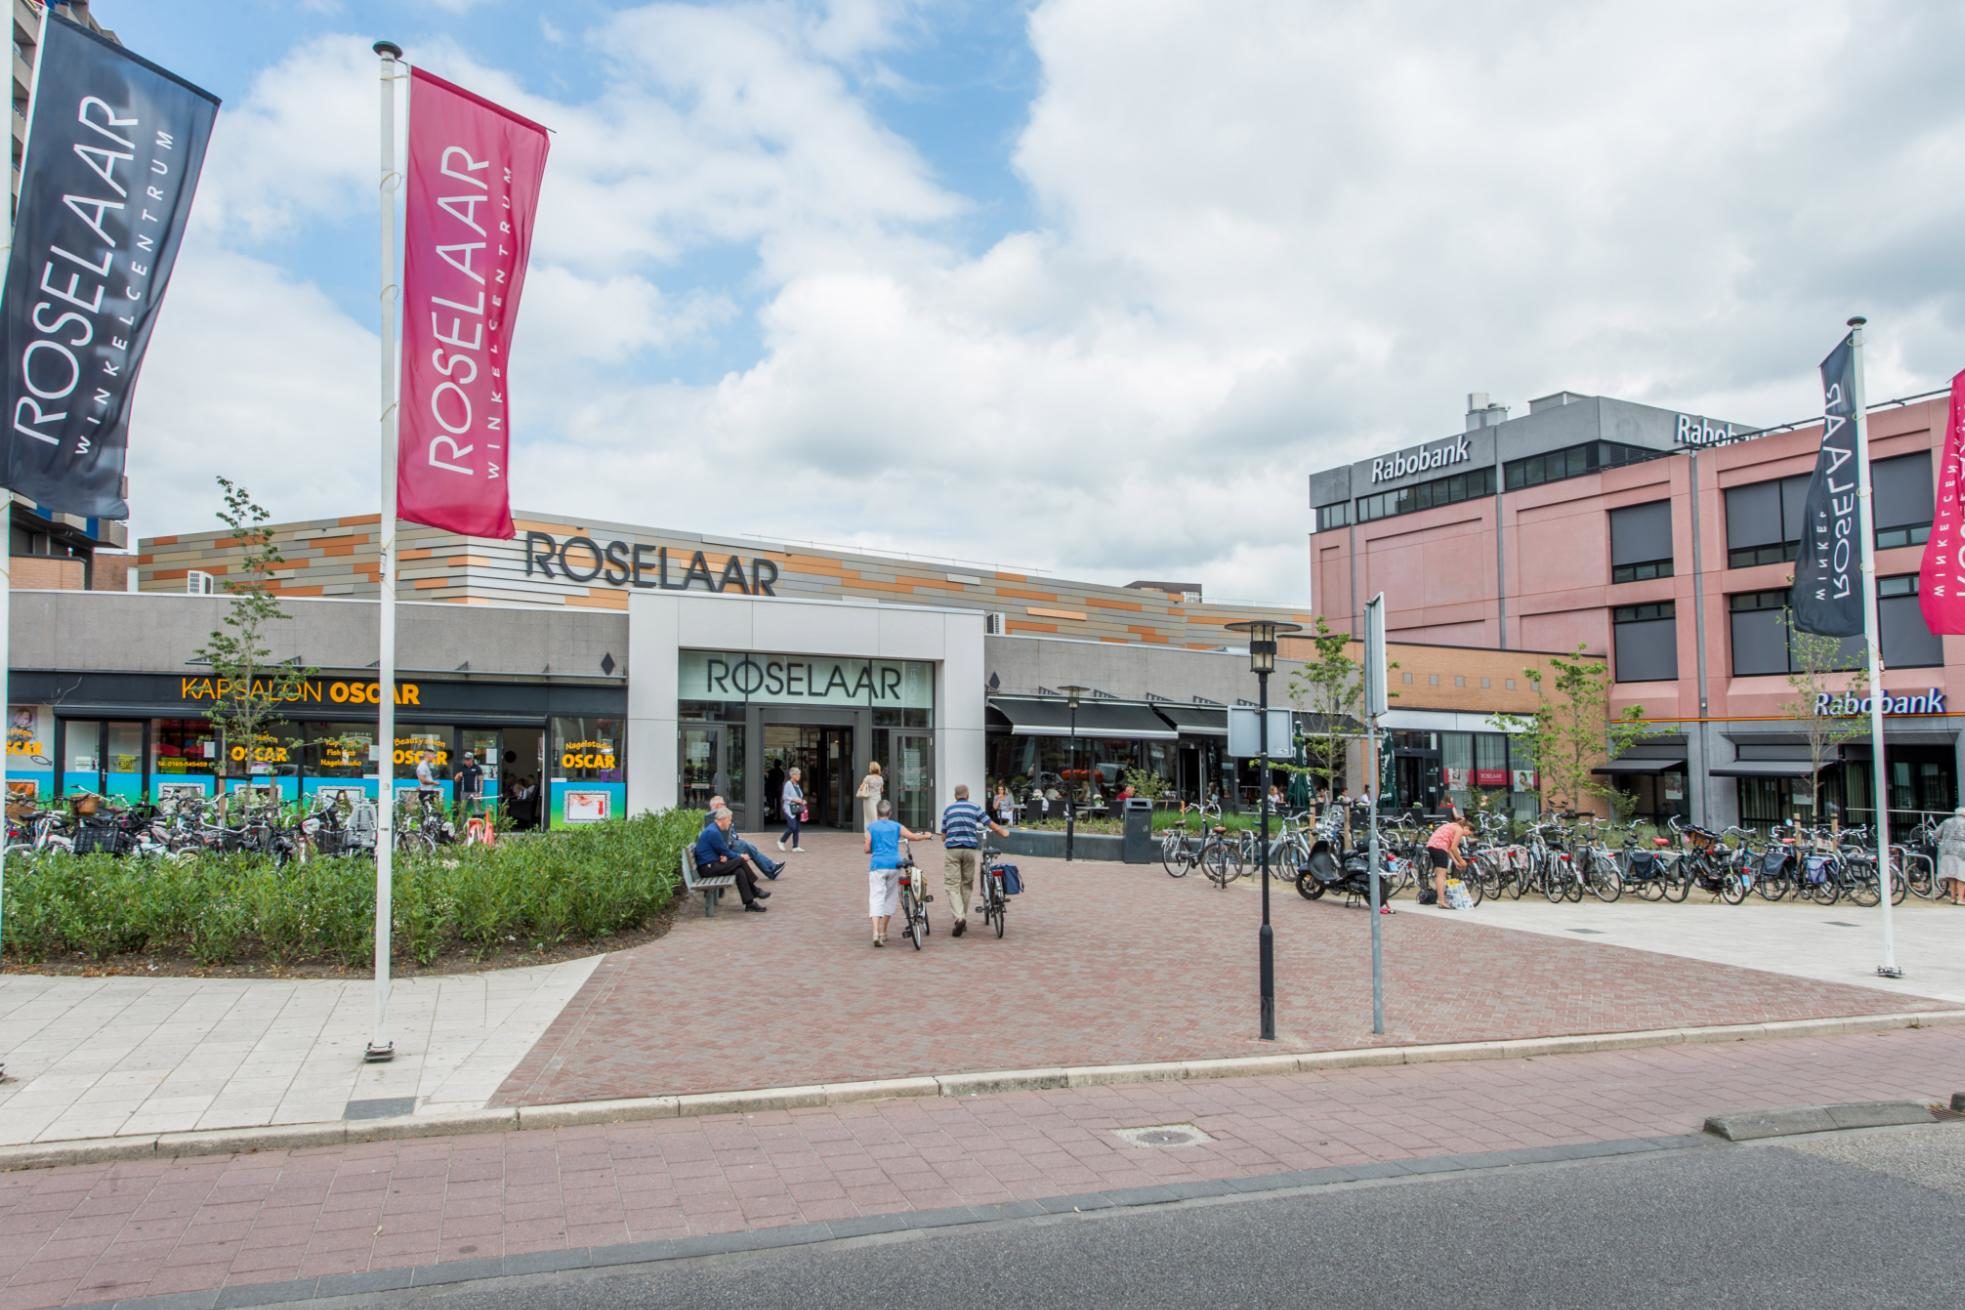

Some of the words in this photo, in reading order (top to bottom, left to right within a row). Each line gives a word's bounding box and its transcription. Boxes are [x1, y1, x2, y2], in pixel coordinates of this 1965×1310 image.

[13, 96, 139, 447] ROSELAAR
[75, 130, 174, 456] WINKELCENTRUM
[429, 145, 490, 476] ROSELAAR
[487, 167, 513, 481] WINKELCENTRUM
[1675, 413, 1768, 448] Rabob
[1371, 434, 1471, 484] Rabobank
[526, 531, 780, 597] ROSELAAR
[181, 677, 322, 703] KAPSALON
[706, 658, 901, 700] ROSELAAR
[1814, 687, 1946, 716] Rabobank
[6, 741, 43, 757] SCAR
[231, 746, 287, 762] OCAR
[393, 750, 448, 766] OSCR
[561, 753, 616, 769] OSCAR
